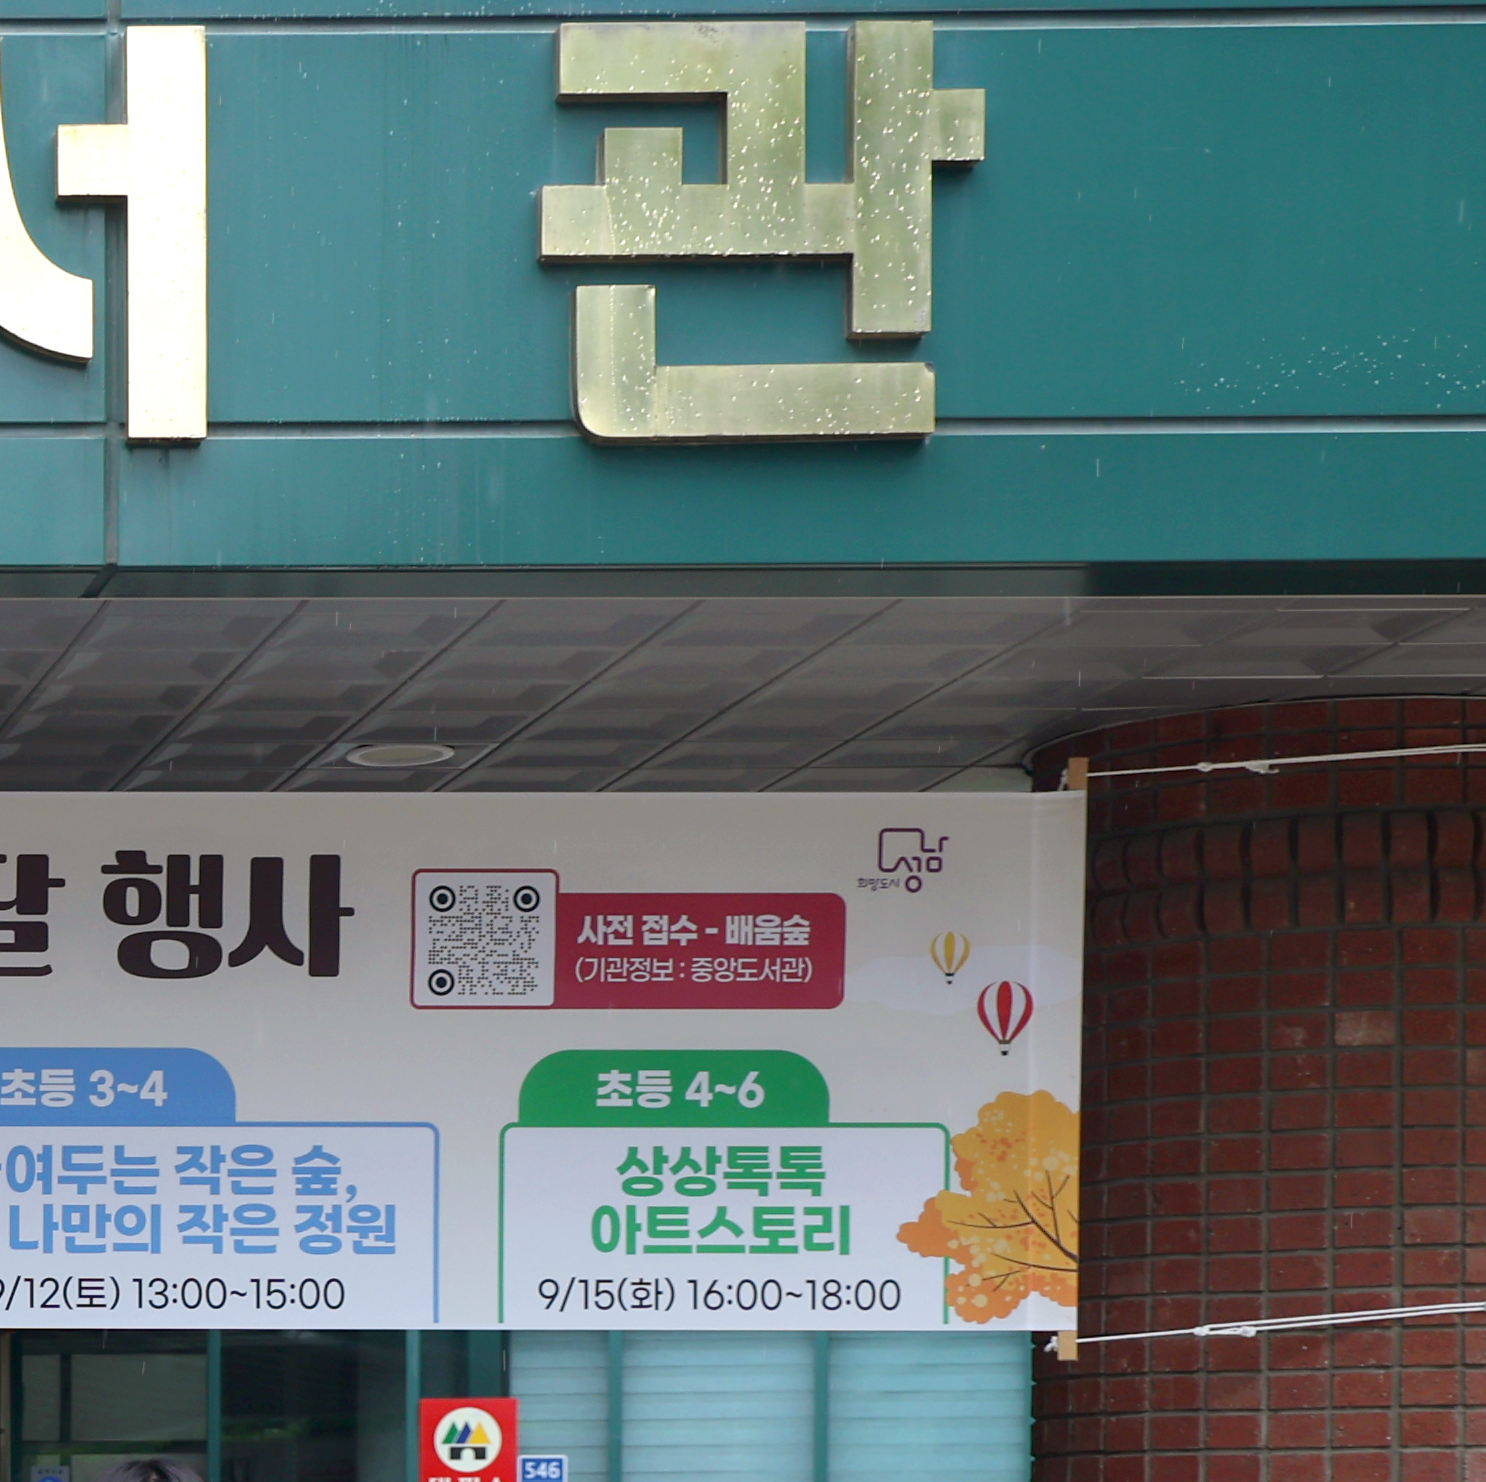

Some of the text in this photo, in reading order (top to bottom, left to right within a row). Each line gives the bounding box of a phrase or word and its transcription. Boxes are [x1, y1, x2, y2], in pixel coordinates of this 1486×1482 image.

[101, 850, 355, 979] 행사
[577, 915, 633, 945] 사전
[642, 915, 698, 946] 접수
[726, 915, 810, 945] 배움숲
[576, 957, 674, 982] (기관정보
[691, 957, 812, 982] 중앙도서관)
[0, 1069, 167, 1107] 초등 3~4
[596, 1070, 765, 1108] 초등 4~6
[175, 1144, 277, 1195] 작은
[292, 1145, 360, 1204] 숲,
[616, 1146, 826, 1197] 상상톡톡
[9, 1204, 395, 1255] 나만의 작은 정원
[591, 1205, 850, 1255] 아트스토리
[133, 1278, 344, 1309] 13:00~15:00
[539, 1277, 900, 1312] 9/15(화) 16:00~18:00
[525, 1462, 560, 1479] 546
